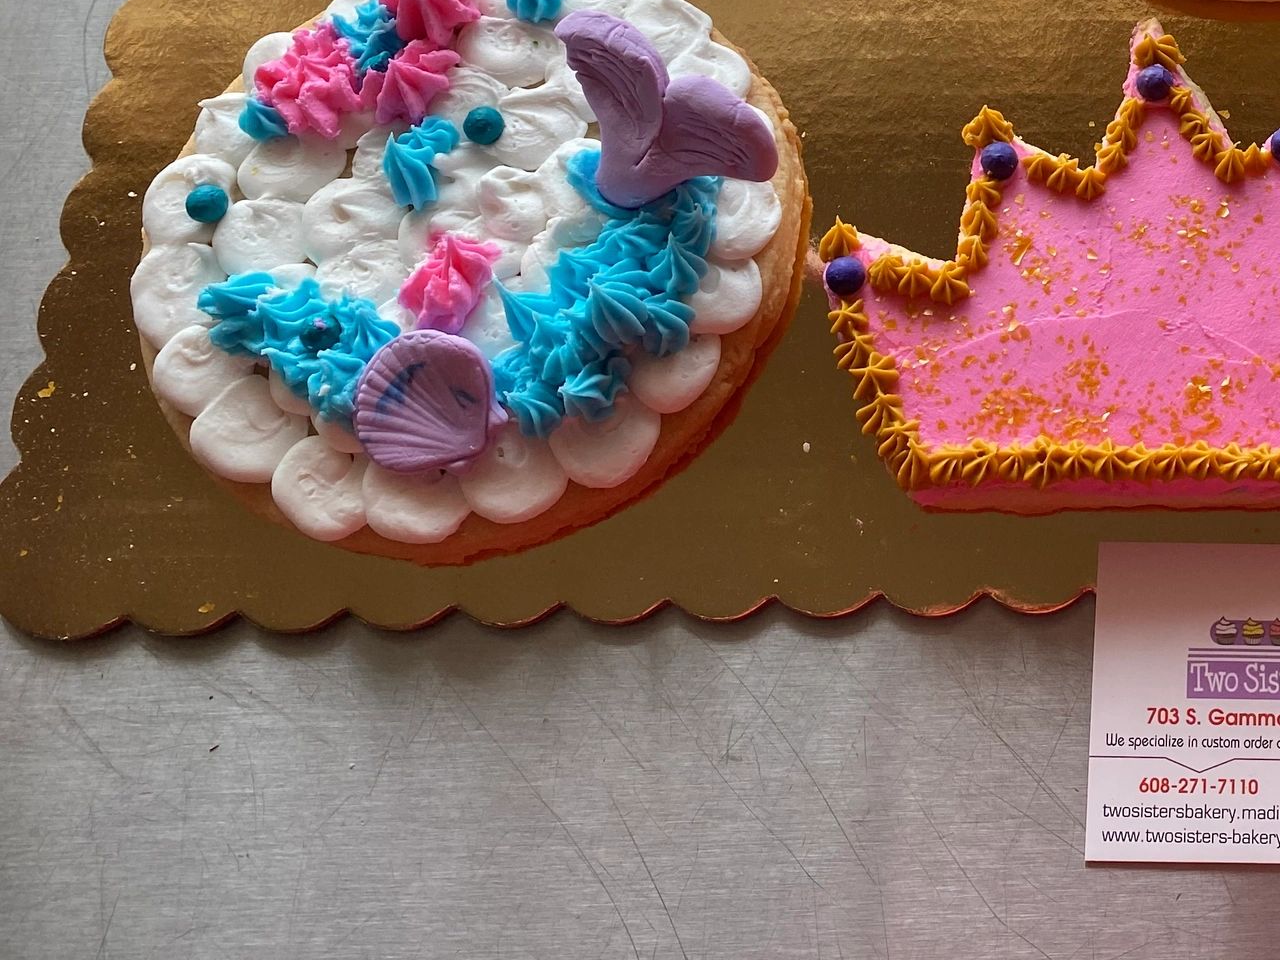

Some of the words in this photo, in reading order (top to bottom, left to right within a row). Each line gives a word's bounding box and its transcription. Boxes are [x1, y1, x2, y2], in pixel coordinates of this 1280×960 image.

[1190, 662, 1239, 692] Two
[1146, 707, 1180, 725] 703
[1185, 708, 1202, 726] S.
[1105, 733, 1125, 747] We
[1128, 734, 1184, 751] specialize
[1188, 735, 1198, 748] in
[1201, 736, 1241, 749] custom
[1243, 735, 1273, 750] order
[1139, 777, 1259, 795] 608-271-7110
